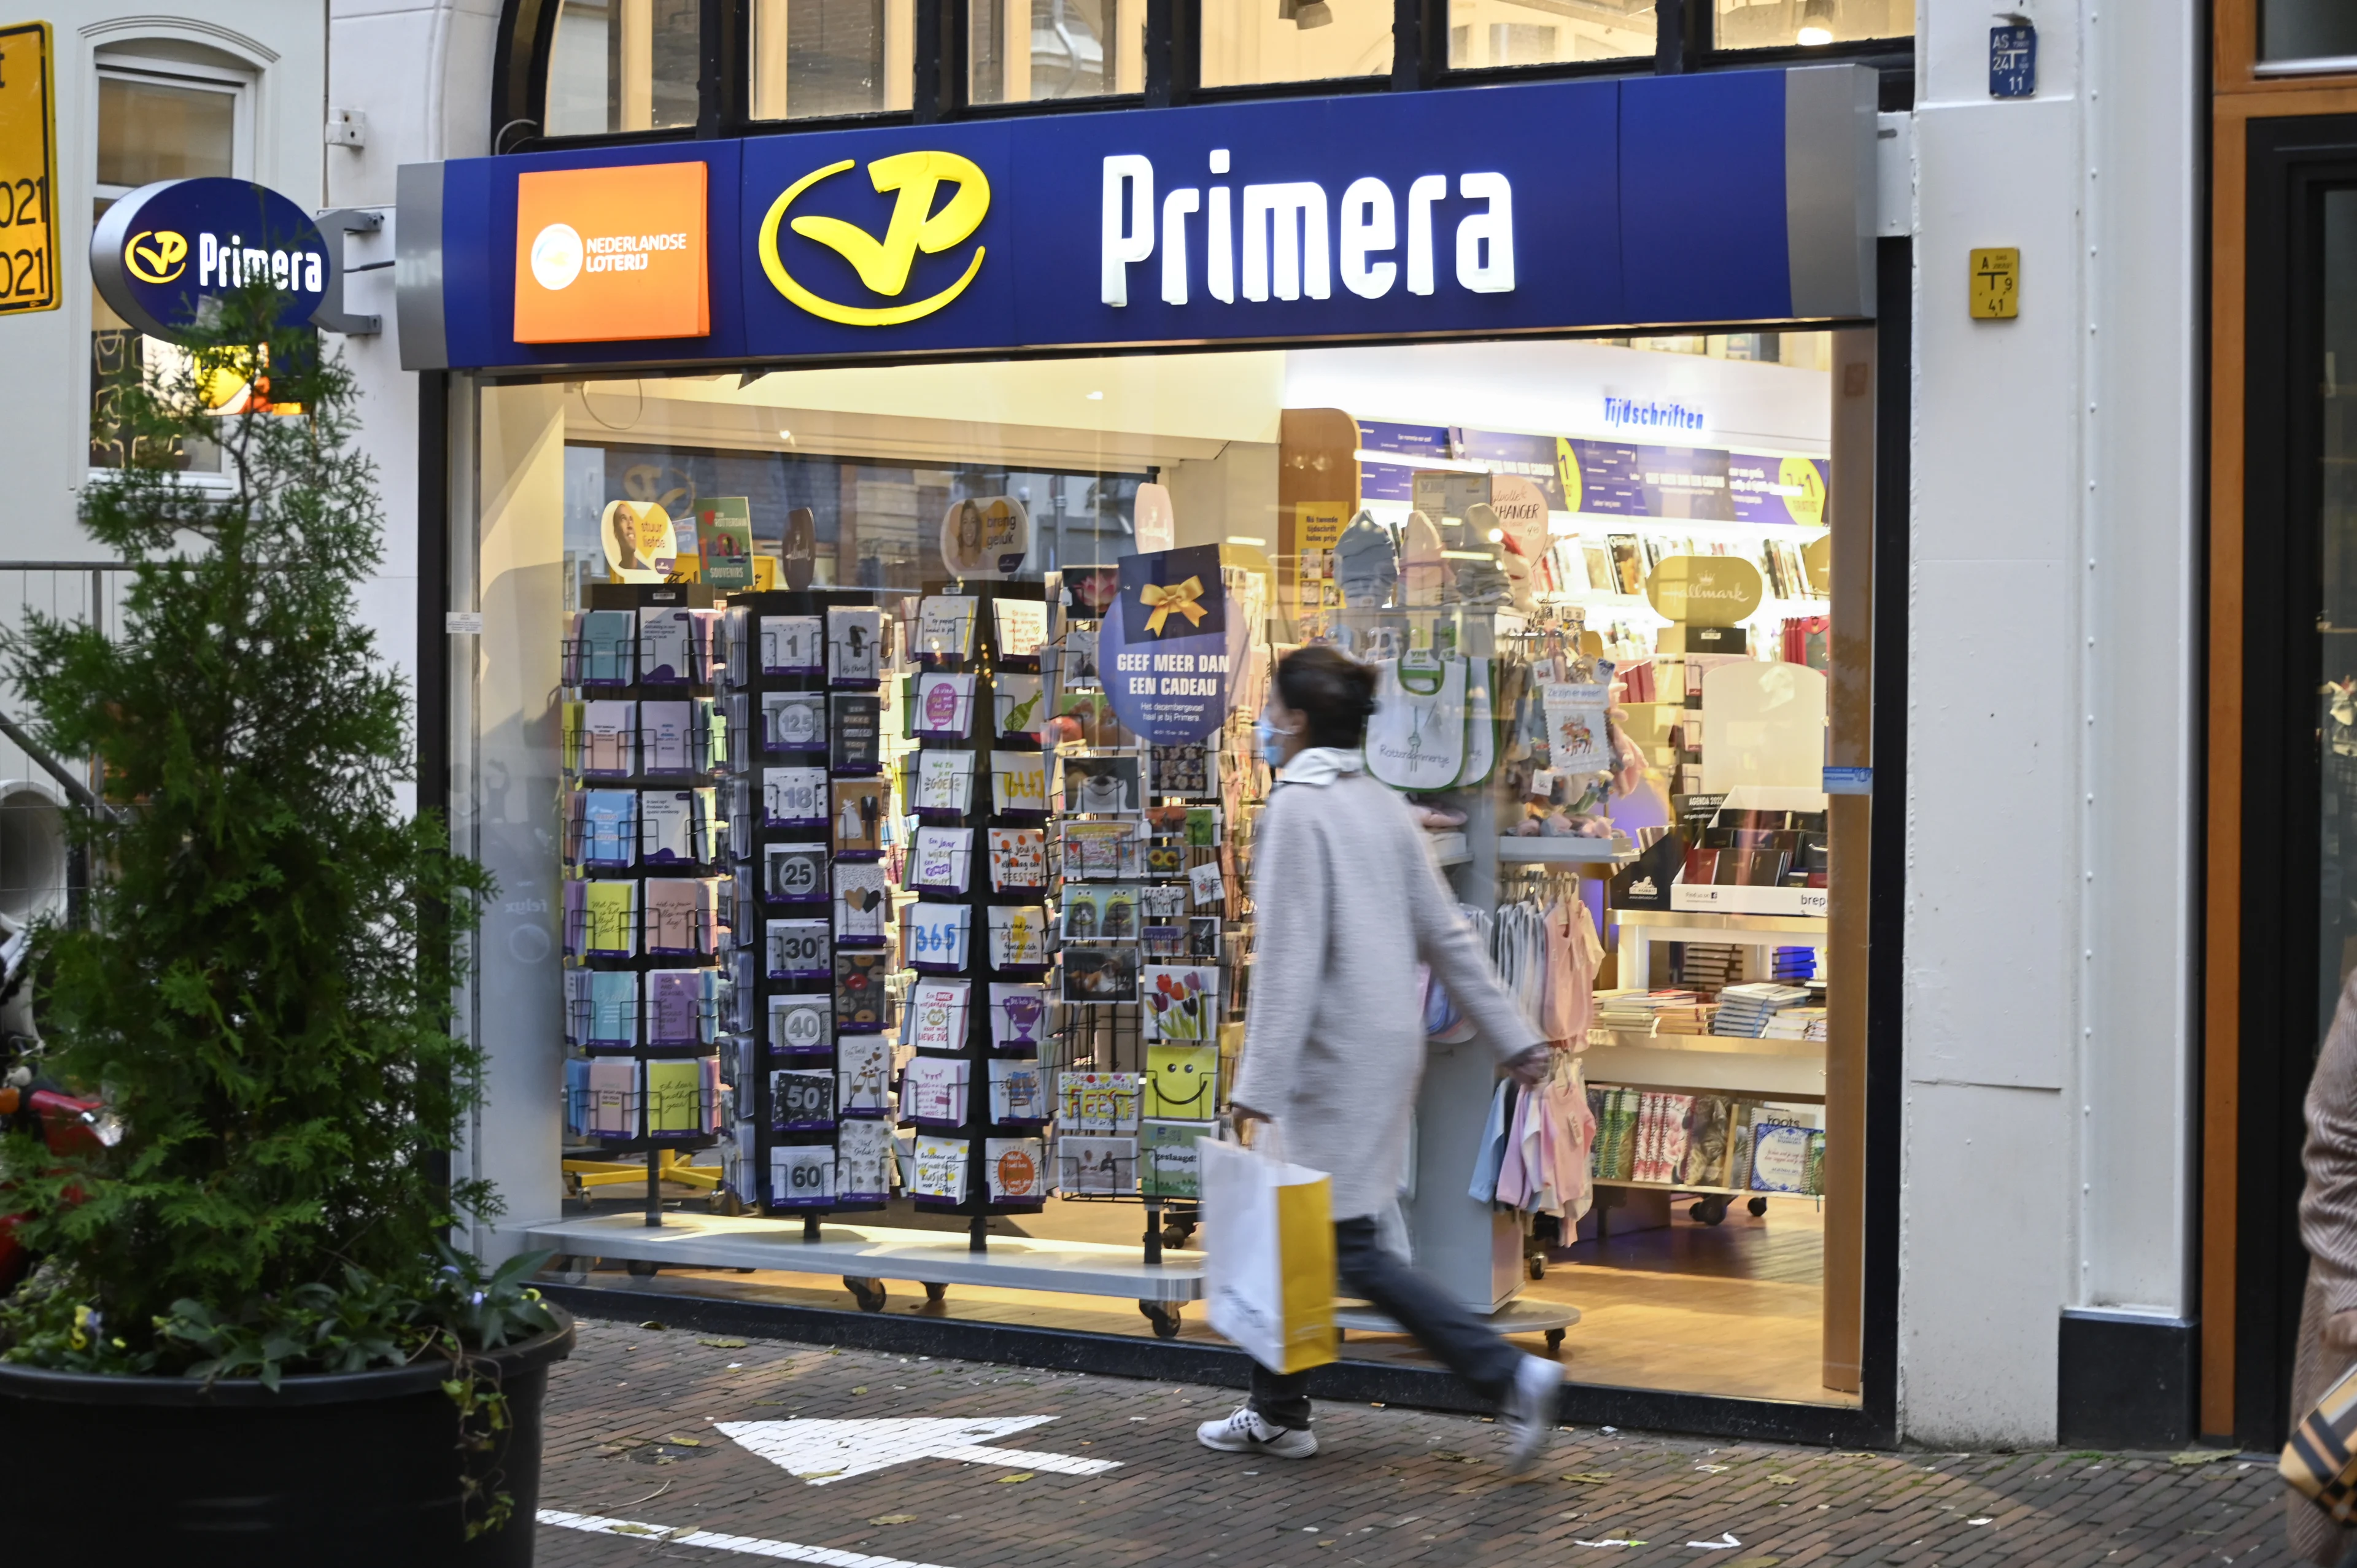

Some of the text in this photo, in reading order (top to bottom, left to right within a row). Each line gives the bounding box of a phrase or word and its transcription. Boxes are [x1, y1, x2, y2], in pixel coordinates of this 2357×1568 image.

[1992, 34, 2010, 49] AS
[1102, 149, 1515, 307] Primera
[586, 231, 687, 254] NEDERLANDSE
[199, 232, 322, 292] Primera
[586, 253, 649, 272] LOTERIJ
[1604, 398, 1704, 430] Tijdschriften
[641, 522, 662, 532] stuur
[714, 517, 748, 528] ROTTERDAM
[987, 516, 1016, 530] breng
[986, 531, 1015, 550] geluk
[710, 567, 744, 579] SOUVENIRS
[1660, 580, 1749, 605] Hallmark
[786, 635, 798, 657] 1
[1117, 653, 1230, 673] GEEF MEER DAN
[1129, 677, 1217, 696] EEN CADEAU
[1140, 702, 1153, 711] Het
[781, 714, 813, 733] 12,5
[1157, 713, 1164, 722] je
[1164, 713, 1173, 722] bij
[1379, 744, 1450, 768] Rotterdammertje
[784, 787, 813, 809] 18
[1689, 797, 1709, 806] AGENDA
[939, 837, 956, 848] jaar
[784, 863, 811, 886] 25
[917, 923, 956, 952] 365
[785, 937, 818, 959] 30
[788, 1015, 818, 1038] 40
[786, 1084, 820, 1109] 50
[1067, 1084, 1134, 1120] FEEST
[1767, 1114, 1800, 1128] roots
[1155, 1152, 1198, 1164] geslaagd!
[792, 1167, 821, 1189] 60
